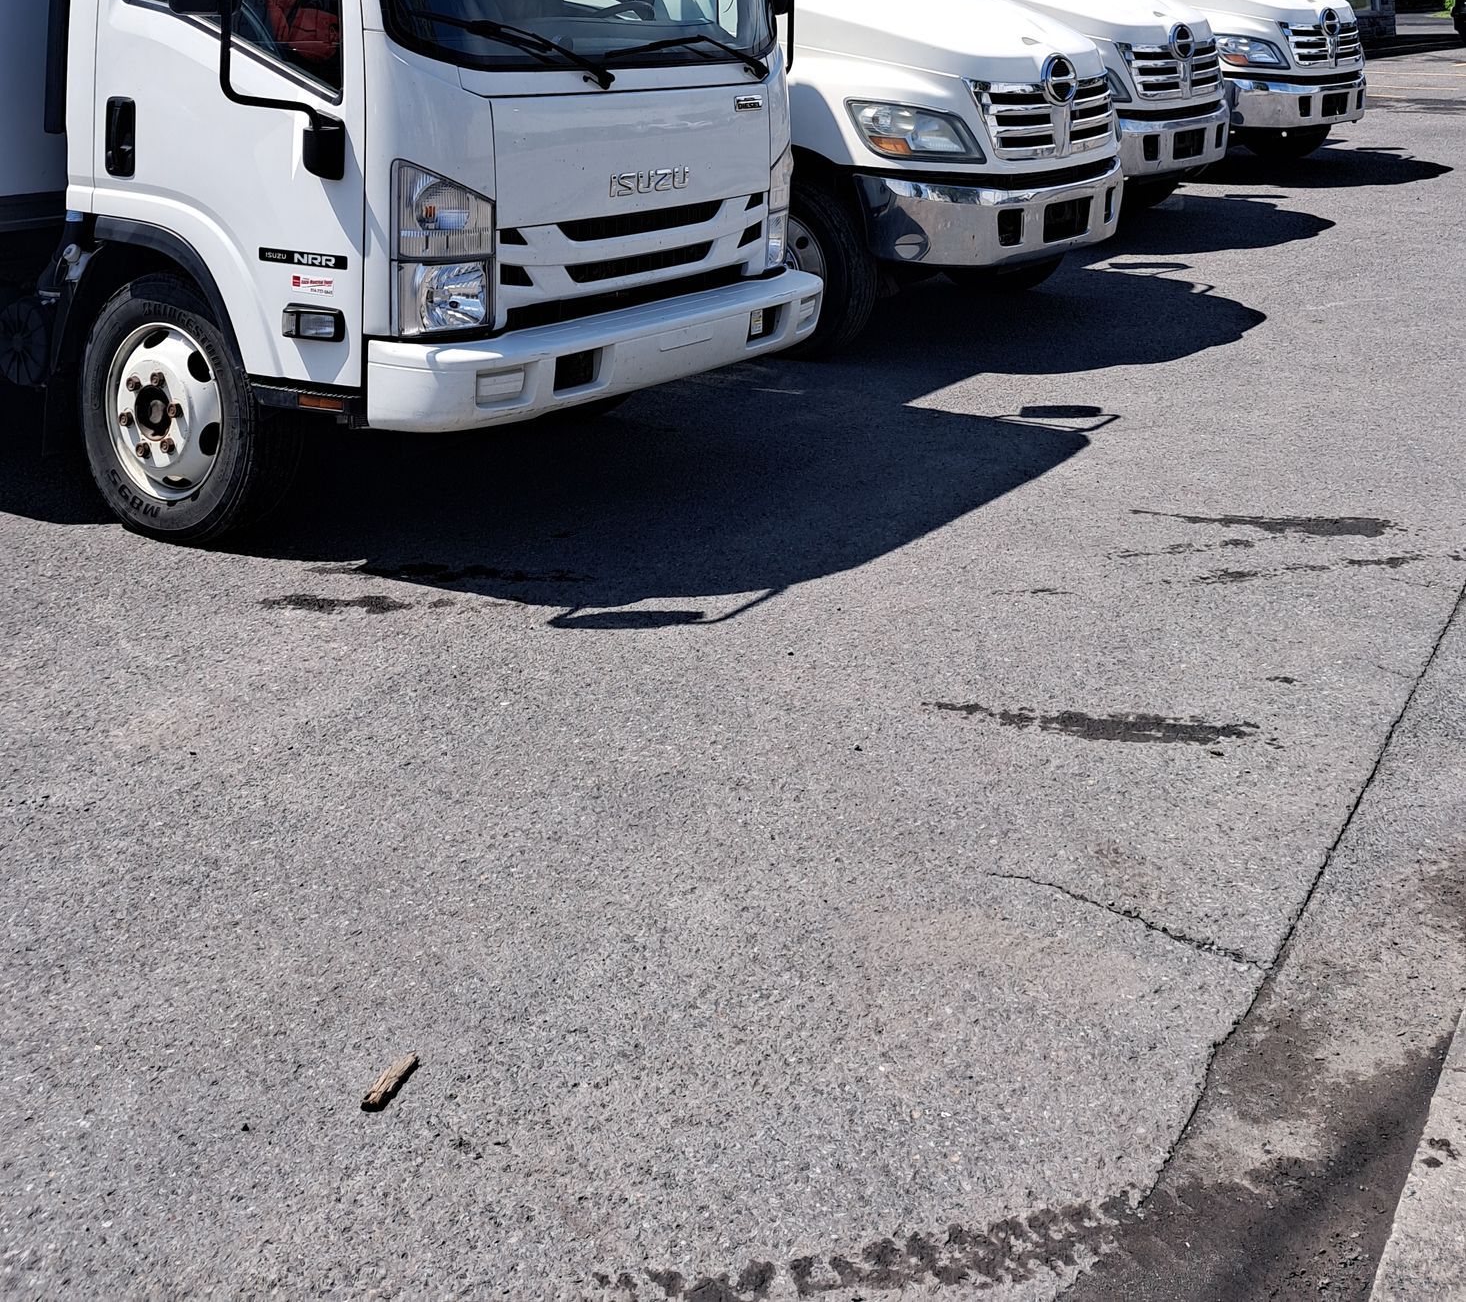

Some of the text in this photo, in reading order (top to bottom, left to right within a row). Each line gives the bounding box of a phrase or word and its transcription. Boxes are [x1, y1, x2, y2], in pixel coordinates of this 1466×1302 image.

[609, 166, 689, 198] ISUZU
[265, 251, 336, 267] ISUZU NRR
